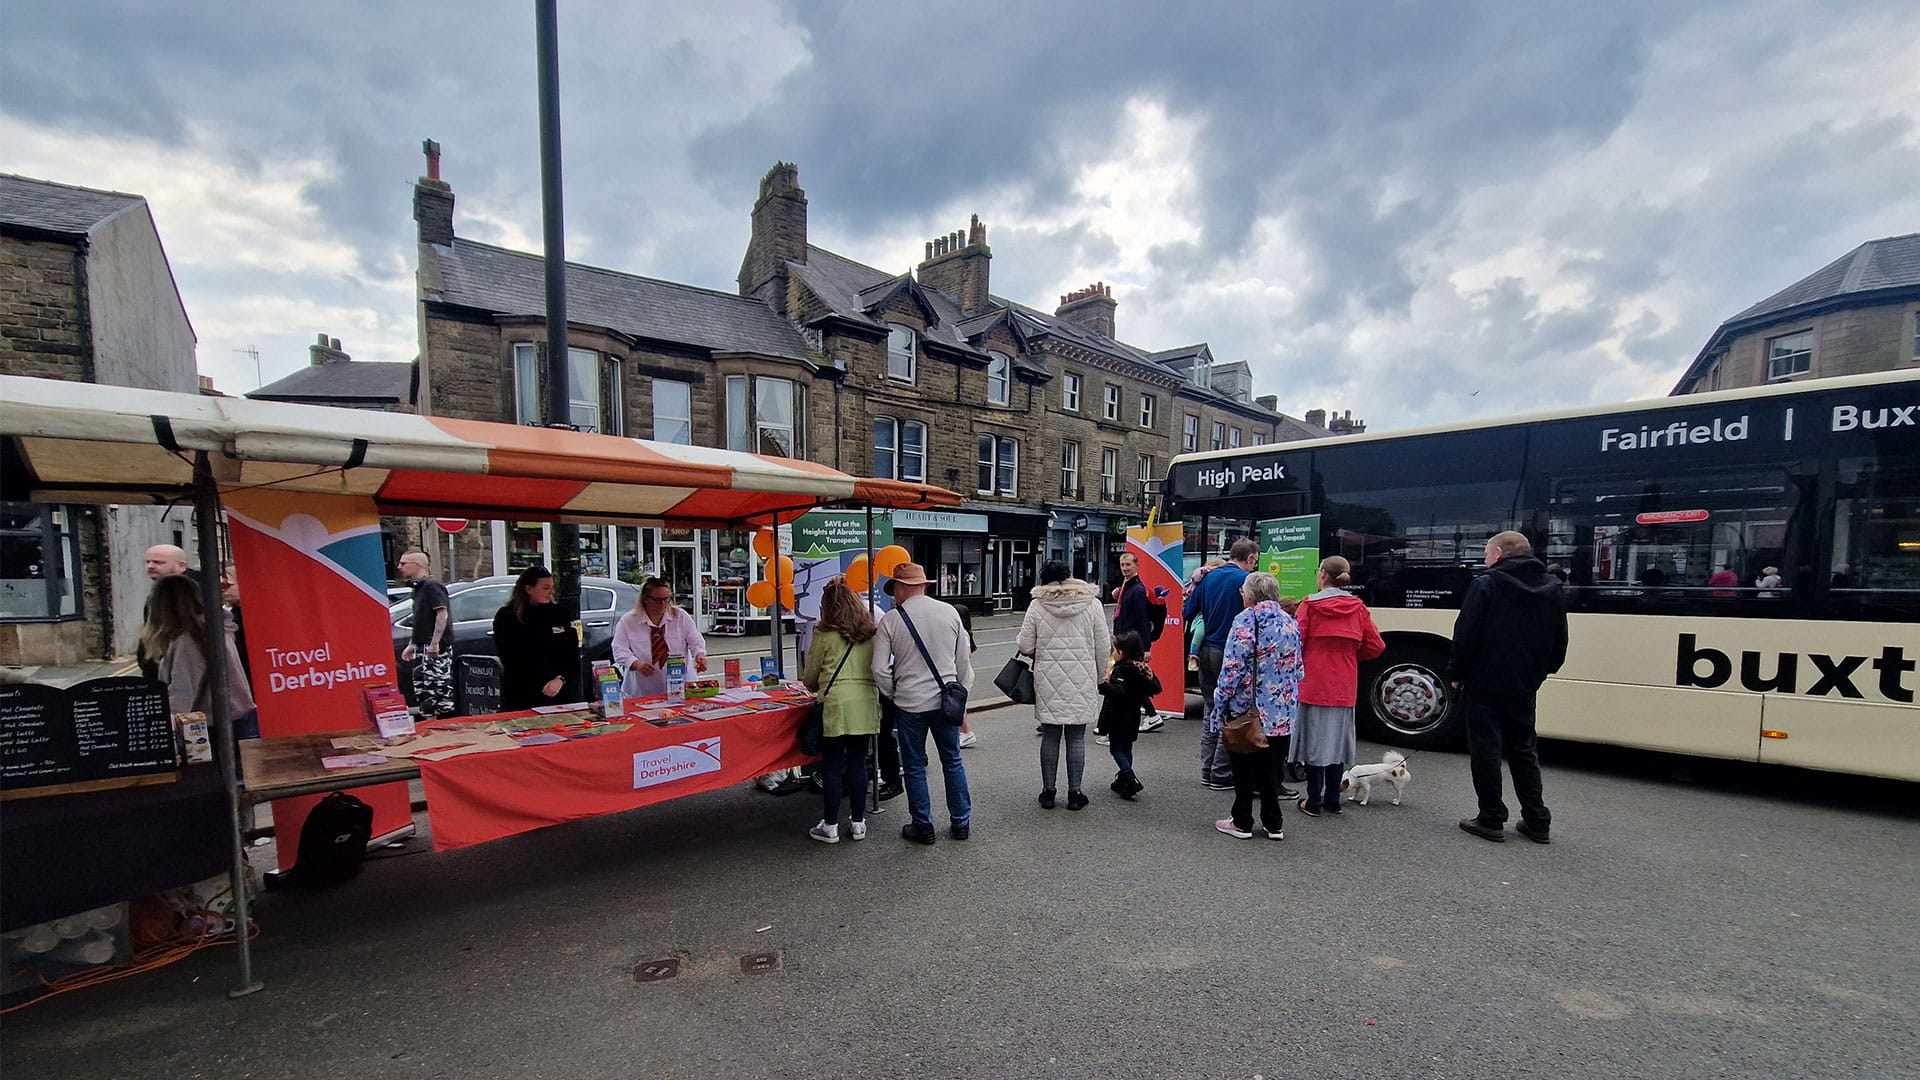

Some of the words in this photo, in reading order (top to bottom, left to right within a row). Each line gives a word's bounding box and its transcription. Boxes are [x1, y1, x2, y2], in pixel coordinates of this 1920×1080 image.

[1602, 415, 1749, 451] Fairfield
[1832, 404, 1920, 432] Bux
[1198, 467, 1236, 489] High
[1242, 462, 1285, 482] Peak
[803, 528, 827, 537] Heights
[828, 528, 836, 536] of
[824, 520, 841, 528] SAVE
[850, 520, 860, 528] the
[825, 536, 860, 545] Transpeak
[265, 642, 331, 668] Travel
[269, 661, 388, 693] Derbyshire
[1676, 633, 1916, 702] buxt
[641, 752, 672, 769] Travel
[641, 761, 697, 780] Derbyshire
